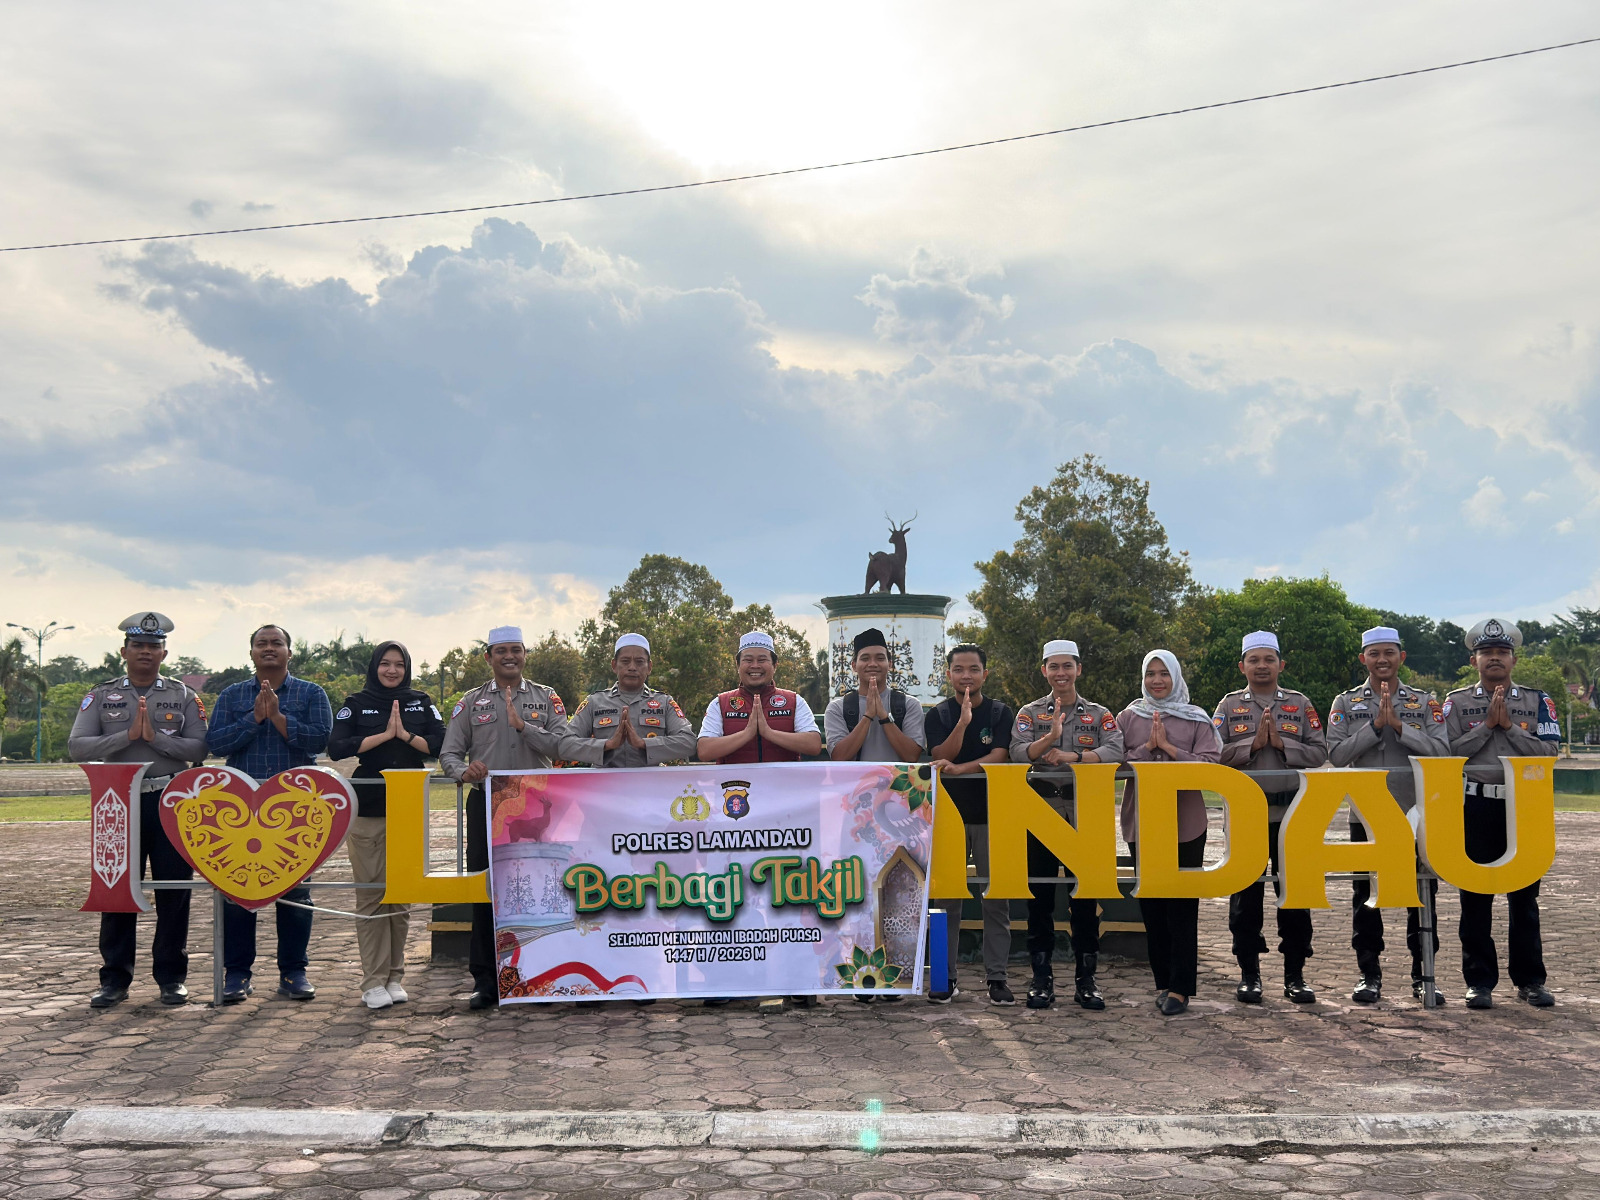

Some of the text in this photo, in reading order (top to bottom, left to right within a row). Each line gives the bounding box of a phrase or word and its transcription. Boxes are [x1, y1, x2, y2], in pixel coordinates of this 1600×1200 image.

[522, 703, 547, 711] POLRI
[1511, 708, 1536, 717] POLRI
[1277, 714, 1302, 722] POLRI
[613, 828, 812, 852] POLRES LAMANDAU
[563, 855, 865, 921] Berbagi Takjil
[609, 928, 821, 948] SELAMAT MENUNIKAN IBADAH PUASA
[665, 947, 766, 963] 1447 H / 2026 M
